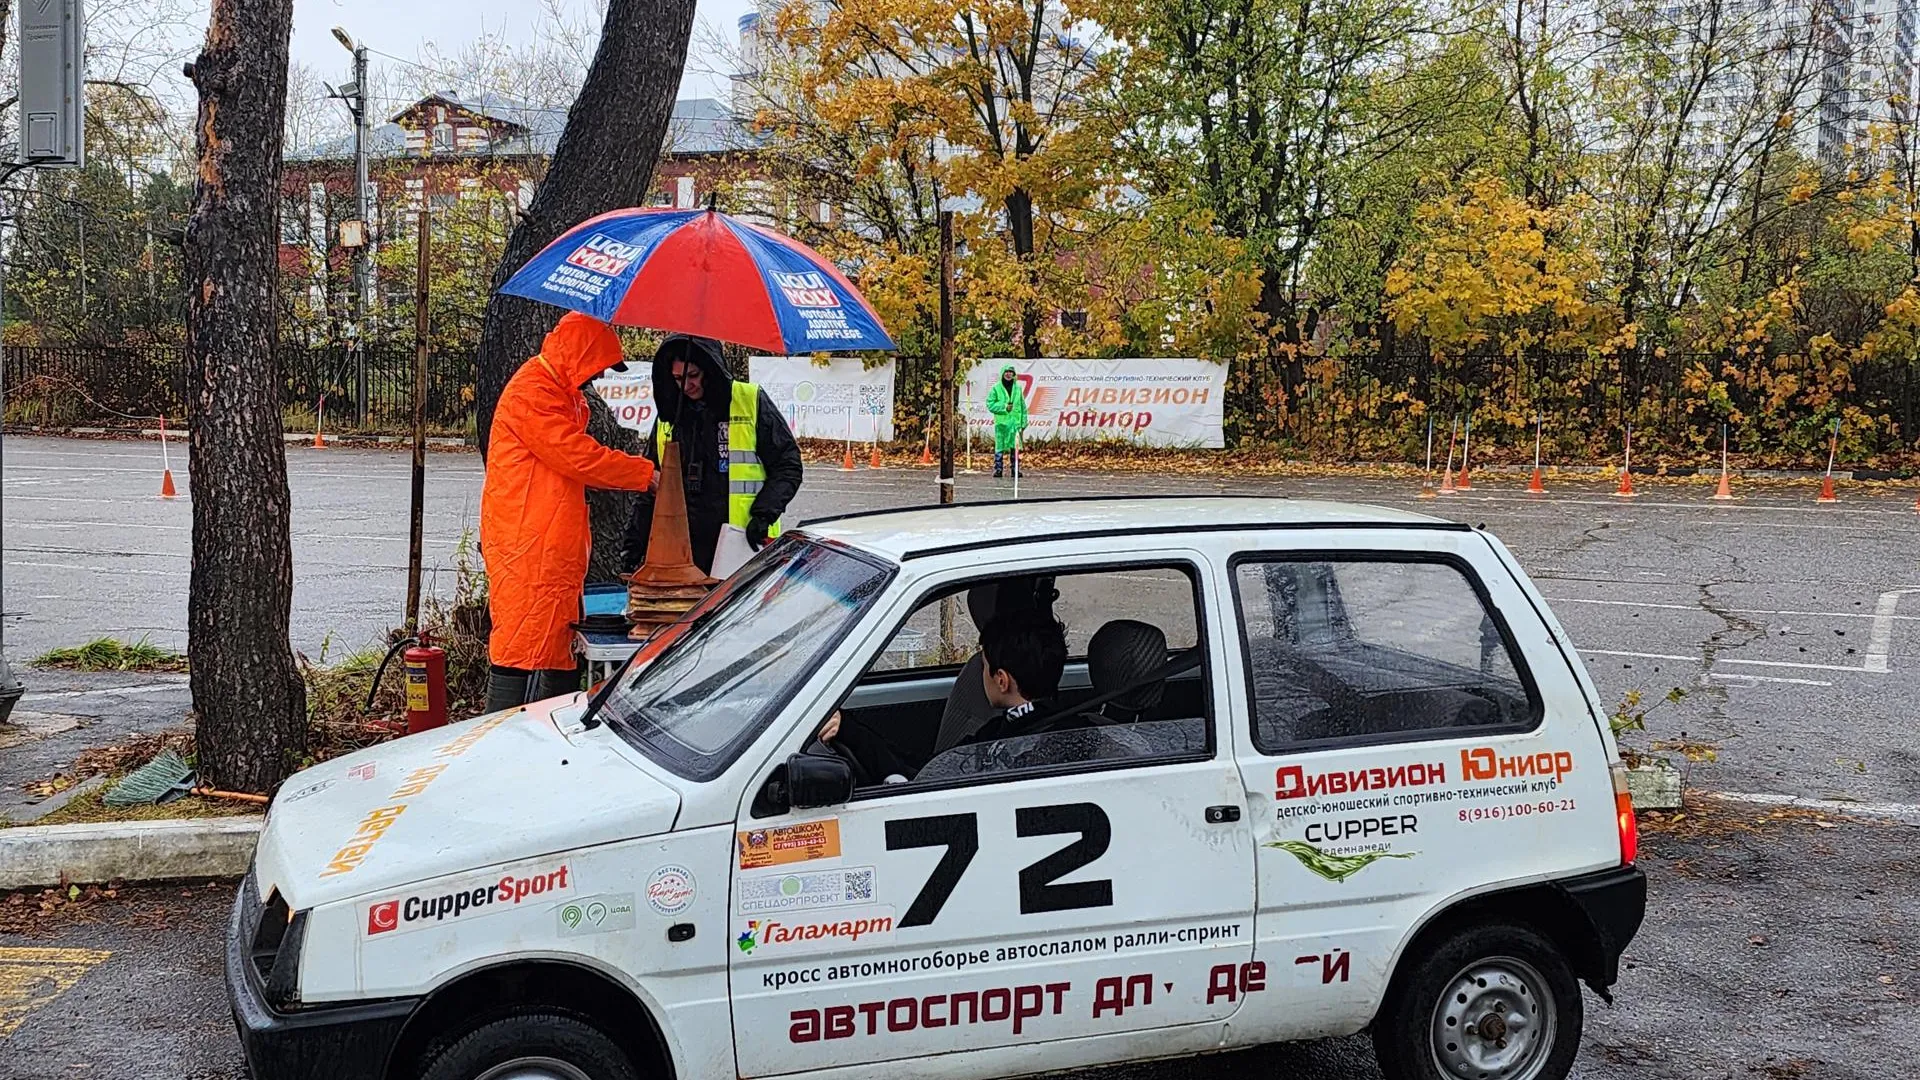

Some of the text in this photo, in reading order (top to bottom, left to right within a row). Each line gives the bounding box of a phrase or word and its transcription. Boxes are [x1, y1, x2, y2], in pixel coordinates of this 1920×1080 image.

[586, 235, 642, 260] LIQUI
[569, 247, 628, 273] MOLY
[555, 264, 612, 287] MOTOR OILS
[555, 275, 603, 296] ADDITIVES
[772, 273, 826, 290] LIQUI
[540, 281, 560, 291] Made
[565, 288, 595, 303] Germany
[783, 289, 834, 305] MOLY
[806, 329, 863, 340] AUTOPFLEGE
[809, 320, 849, 329] ADDITIVE
[1064, 387, 1210, 407] ДИВИЗИОН
[1275, 747, 1573, 800] Дивизион Юниор
[1277, 777, 1557, 820] детско-юношеский спортивно-технический клуб
[1459, 800, 1577, 823] 8(916)100-60-21
[772, 823, 825, 837] АВТОШКОЛА
[1304, 814, 1418, 843] CUPPER
[884, 802, 1114, 929] 72
[403, 865, 569, 922] CupperSport
[742, 893, 841, 910] СПЕЦДОРПРОЕКТ
[763, 916, 892, 944] Галамарт
[762, 923, 1241, 990] кросс автомногоборье автослалом ралли-спринт
[788, 981, 1072, 1043] автоспорт
